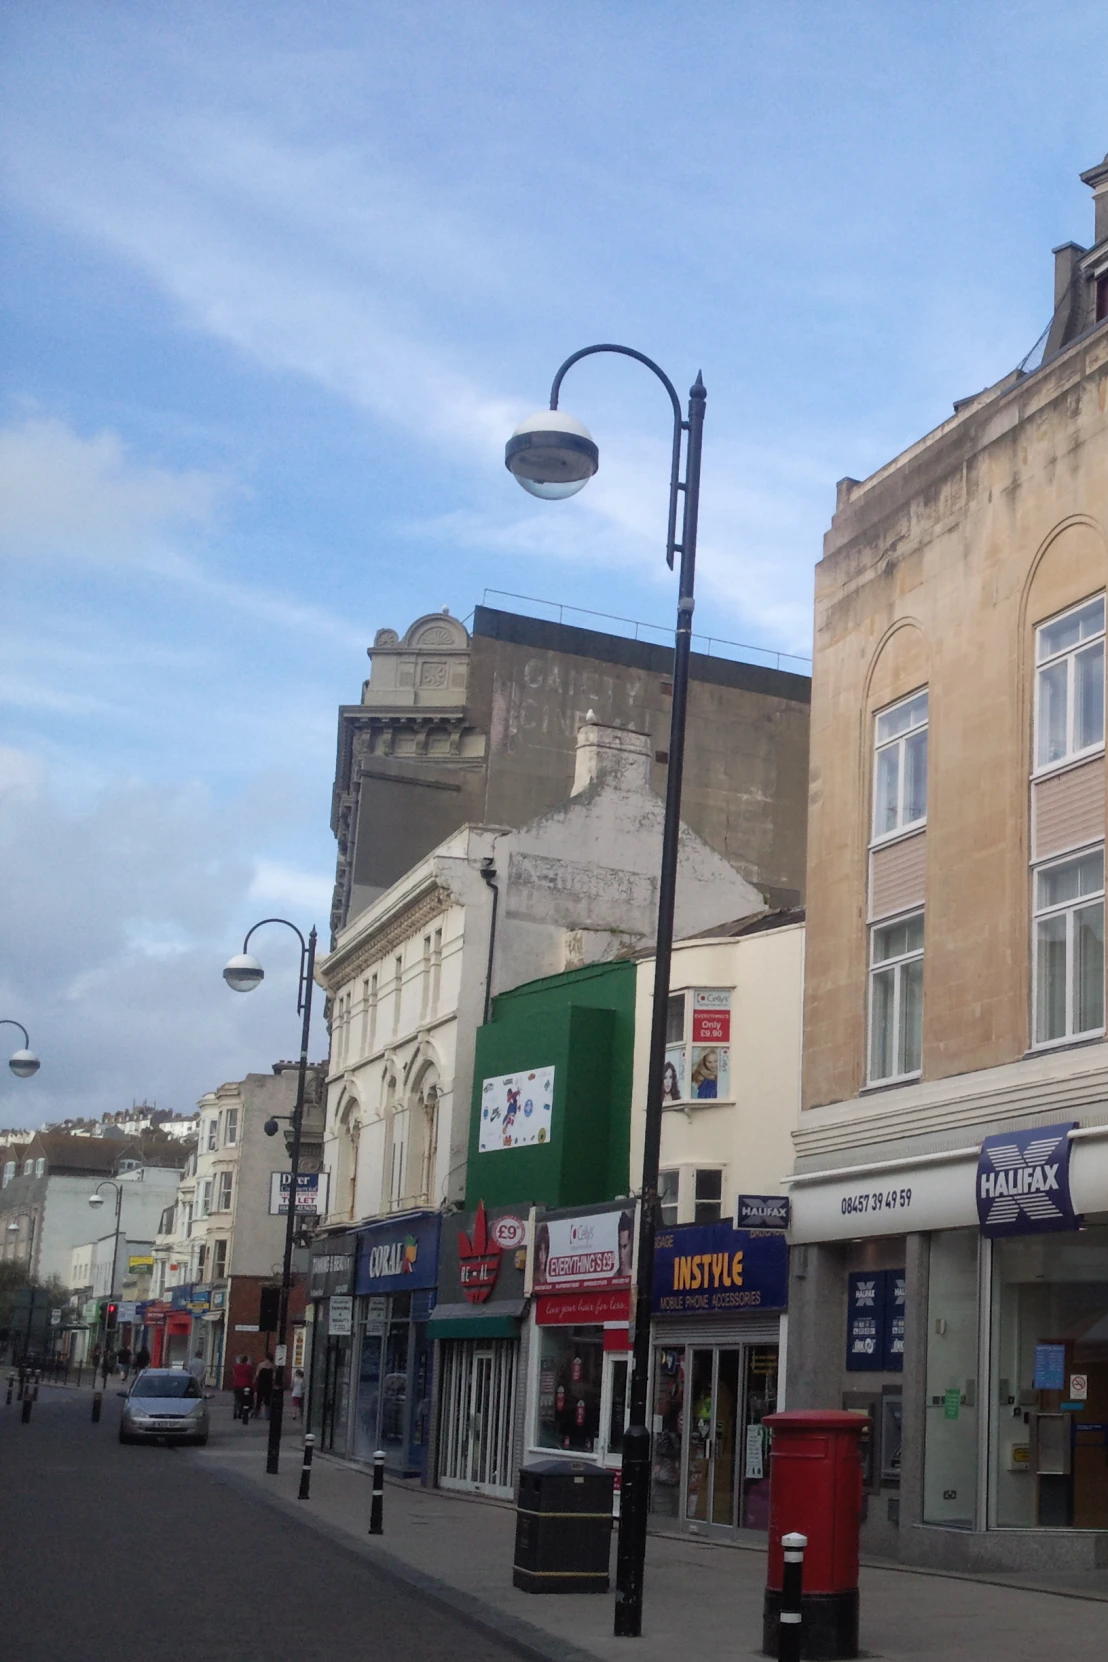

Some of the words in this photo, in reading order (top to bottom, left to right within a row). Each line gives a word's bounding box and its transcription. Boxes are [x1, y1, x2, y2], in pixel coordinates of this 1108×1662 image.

[700, 1029, 723, 1038] £9.90
[701, 1020, 721, 1030] Only
[282, 1173, 310, 1185] Der
[981, 1163, 1060, 1199] HALIFAX
[742, 1206, 787, 1217] HALIFAX
[841, 1194, 870, 1215] 08457
[871, 1192, 884, 1211] 39
[885, 1190, 898, 1209] 49
[899, 1188, 912, 1208] 59
[369, 1243, 402, 1278] CORAL
[550, 1255, 602, 1276] EVERYTHING'S
[673, 1250, 743, 1291] INSTYLE
[660, 1296, 684, 1310] MOBILE
[685, 1294, 709, 1308] PHONE
[711, 1290, 761, 1307] ACCESSORIES
[855, 1289, 876, 1299] HALIFAX
[559, 1304, 576, 1319] your
[577, 1298, 594, 1312] hair
[595, 1298, 609, 1315] for
